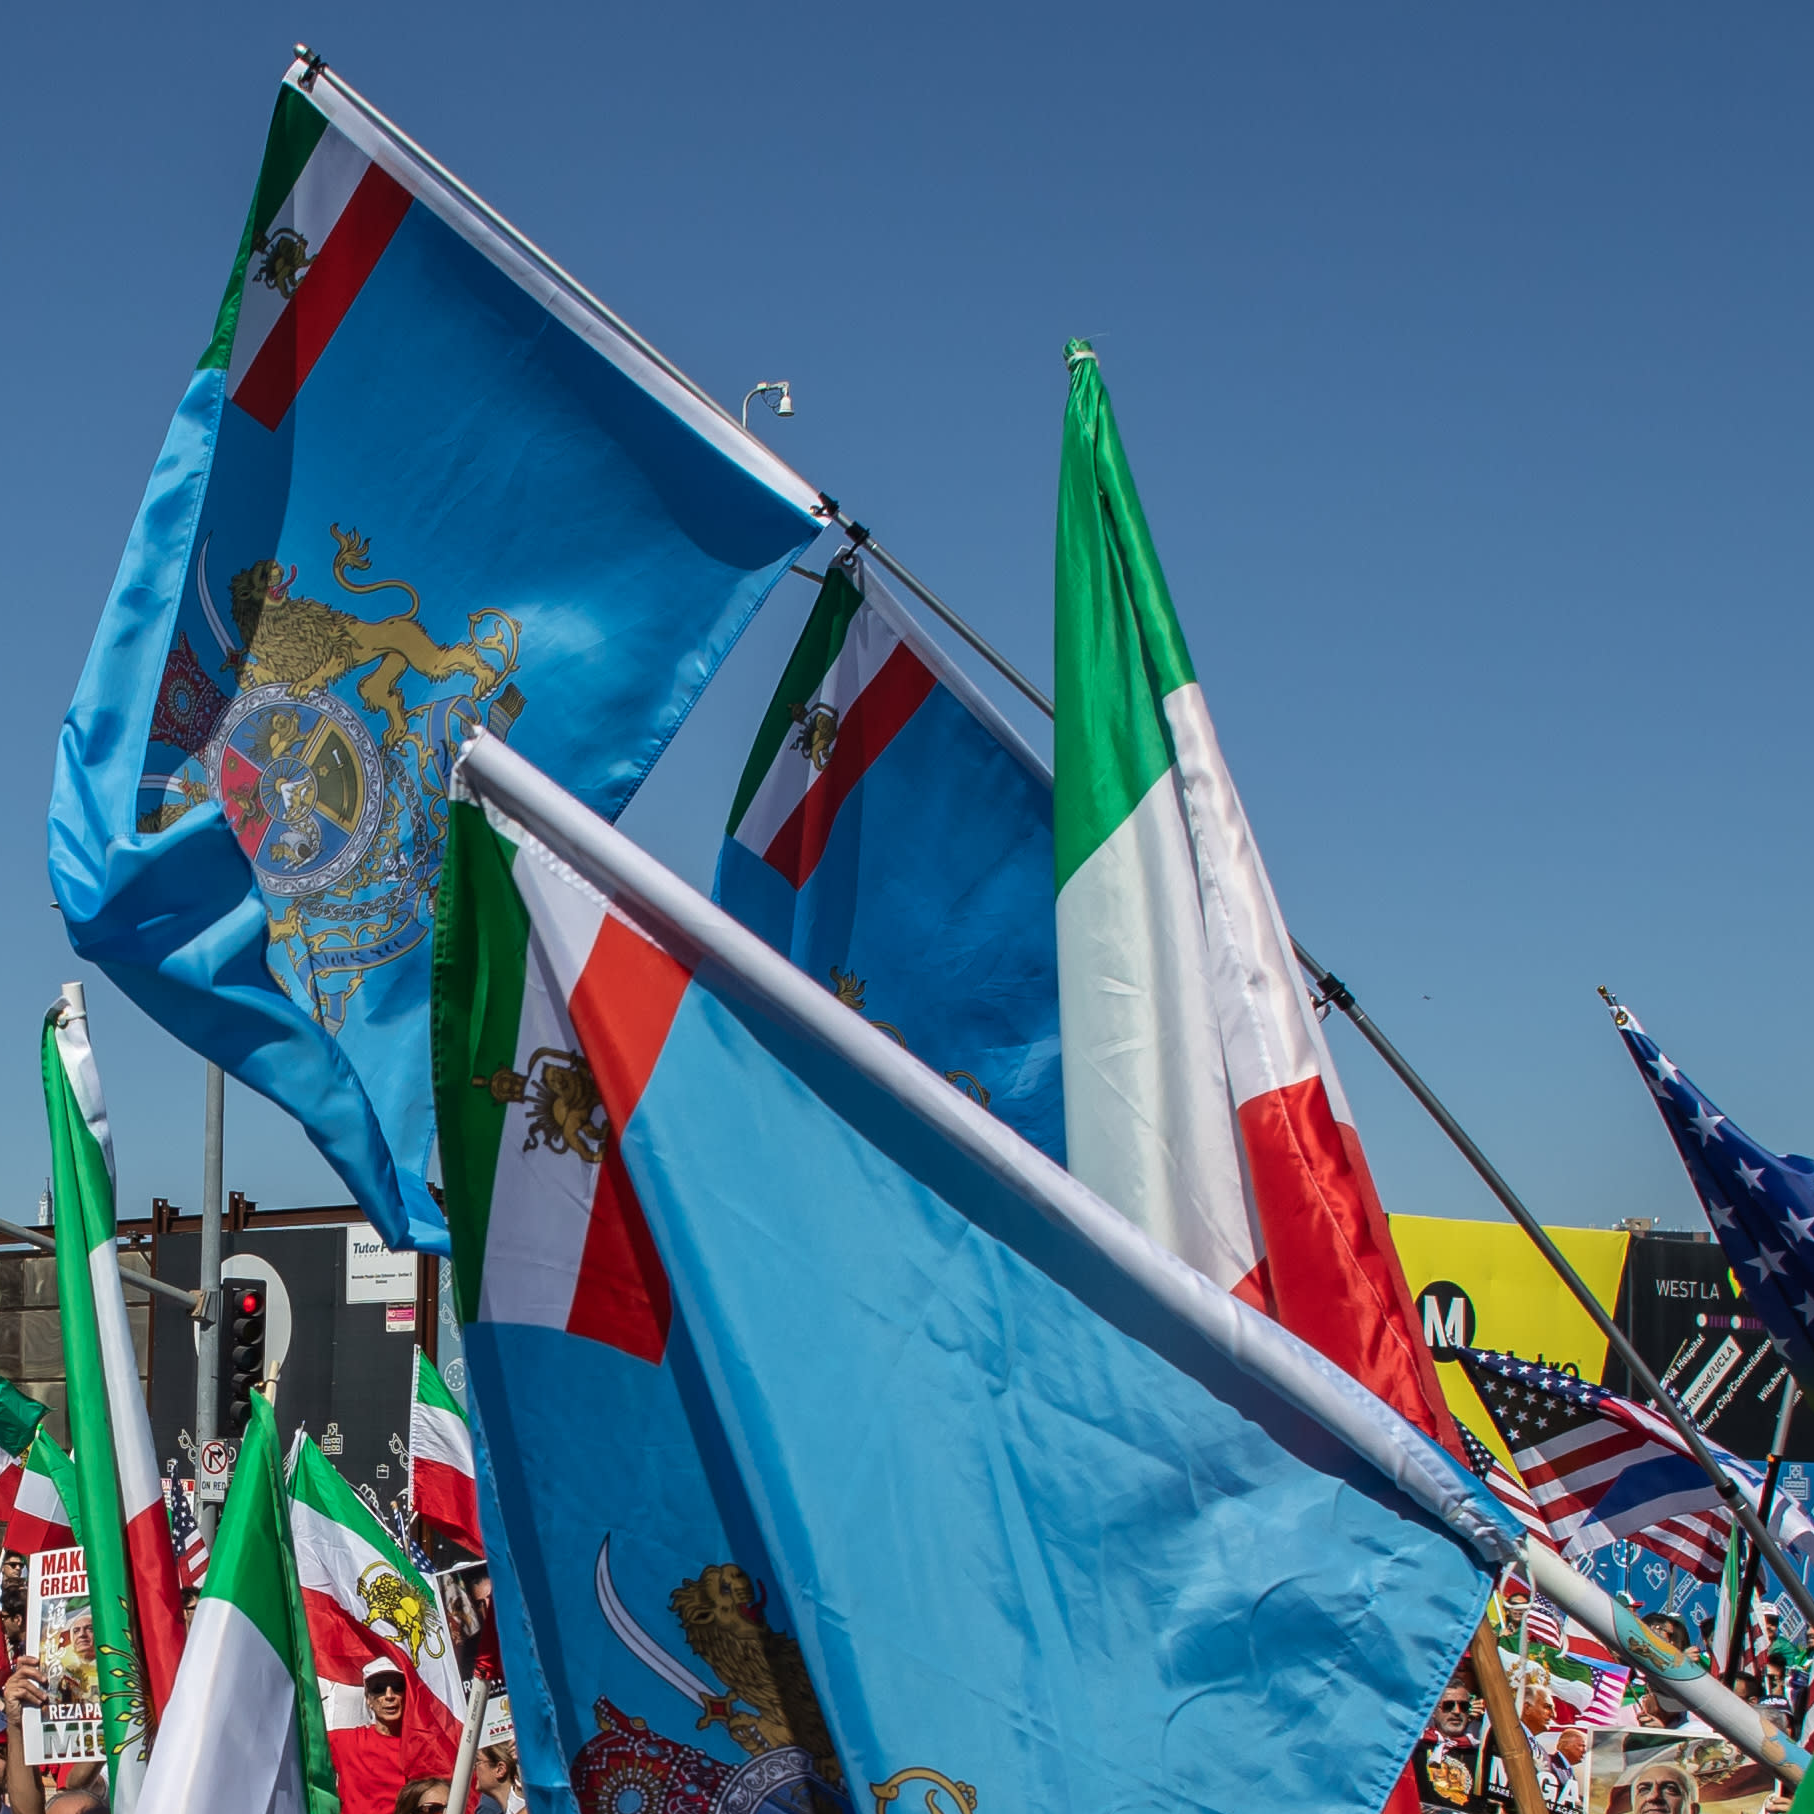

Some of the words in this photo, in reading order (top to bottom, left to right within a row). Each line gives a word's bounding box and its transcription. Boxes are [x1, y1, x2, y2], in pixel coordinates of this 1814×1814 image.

[353, 1243, 380, 1254] Tutor
[1656, 1279, 1697, 1298] WEST
[1701, 1283, 1719, 1299] LA
[1424, 1294, 1466, 1348] M
[1677, 1332, 1706, 1370] Hospital
[1687, 1345, 1736, 1410] stwood/UCLA
[1699, 1408, 1720, 1433] ntury
[1716, 1338, 1772, 1410] City/Constellation
[202, 1481, 210, 1490] ON
[213, 1481, 226, 1491] RED
[40, 1574, 87, 1597] GREAT
[49, 1704, 82, 1721] REZA
[43, 1722, 107, 1760] MI
[1489, 1756, 1580, 1809] MGA
